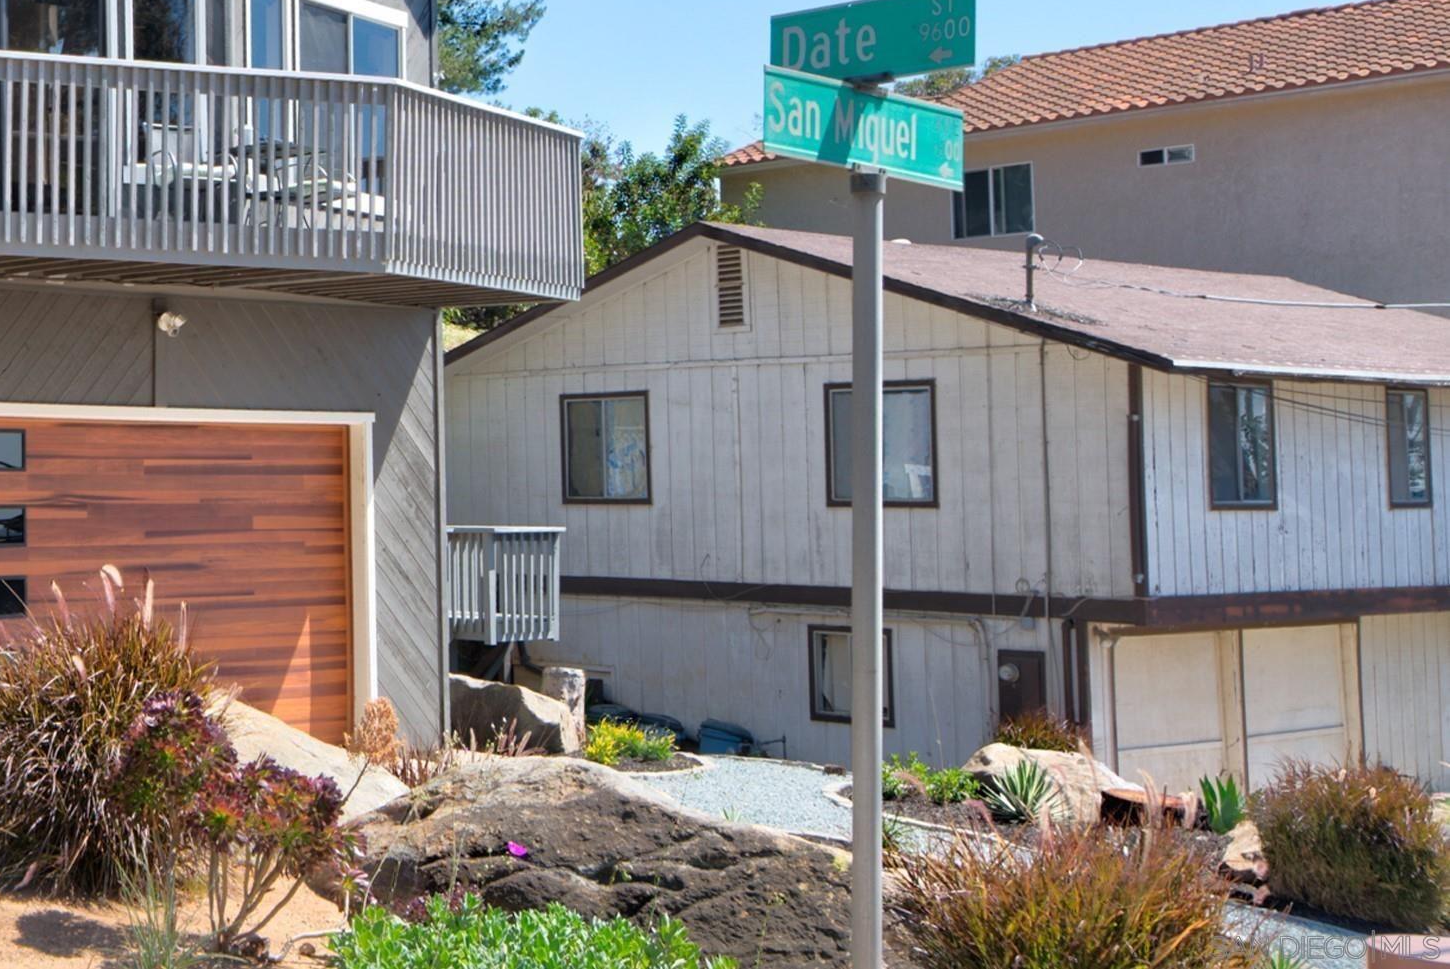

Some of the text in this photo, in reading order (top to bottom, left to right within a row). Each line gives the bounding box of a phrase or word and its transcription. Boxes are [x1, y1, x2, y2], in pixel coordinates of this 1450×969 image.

[782, 17, 877, 70] Date
[918, 16, 971, 42] 9600
[767, 81, 917, 165] San Miguel
